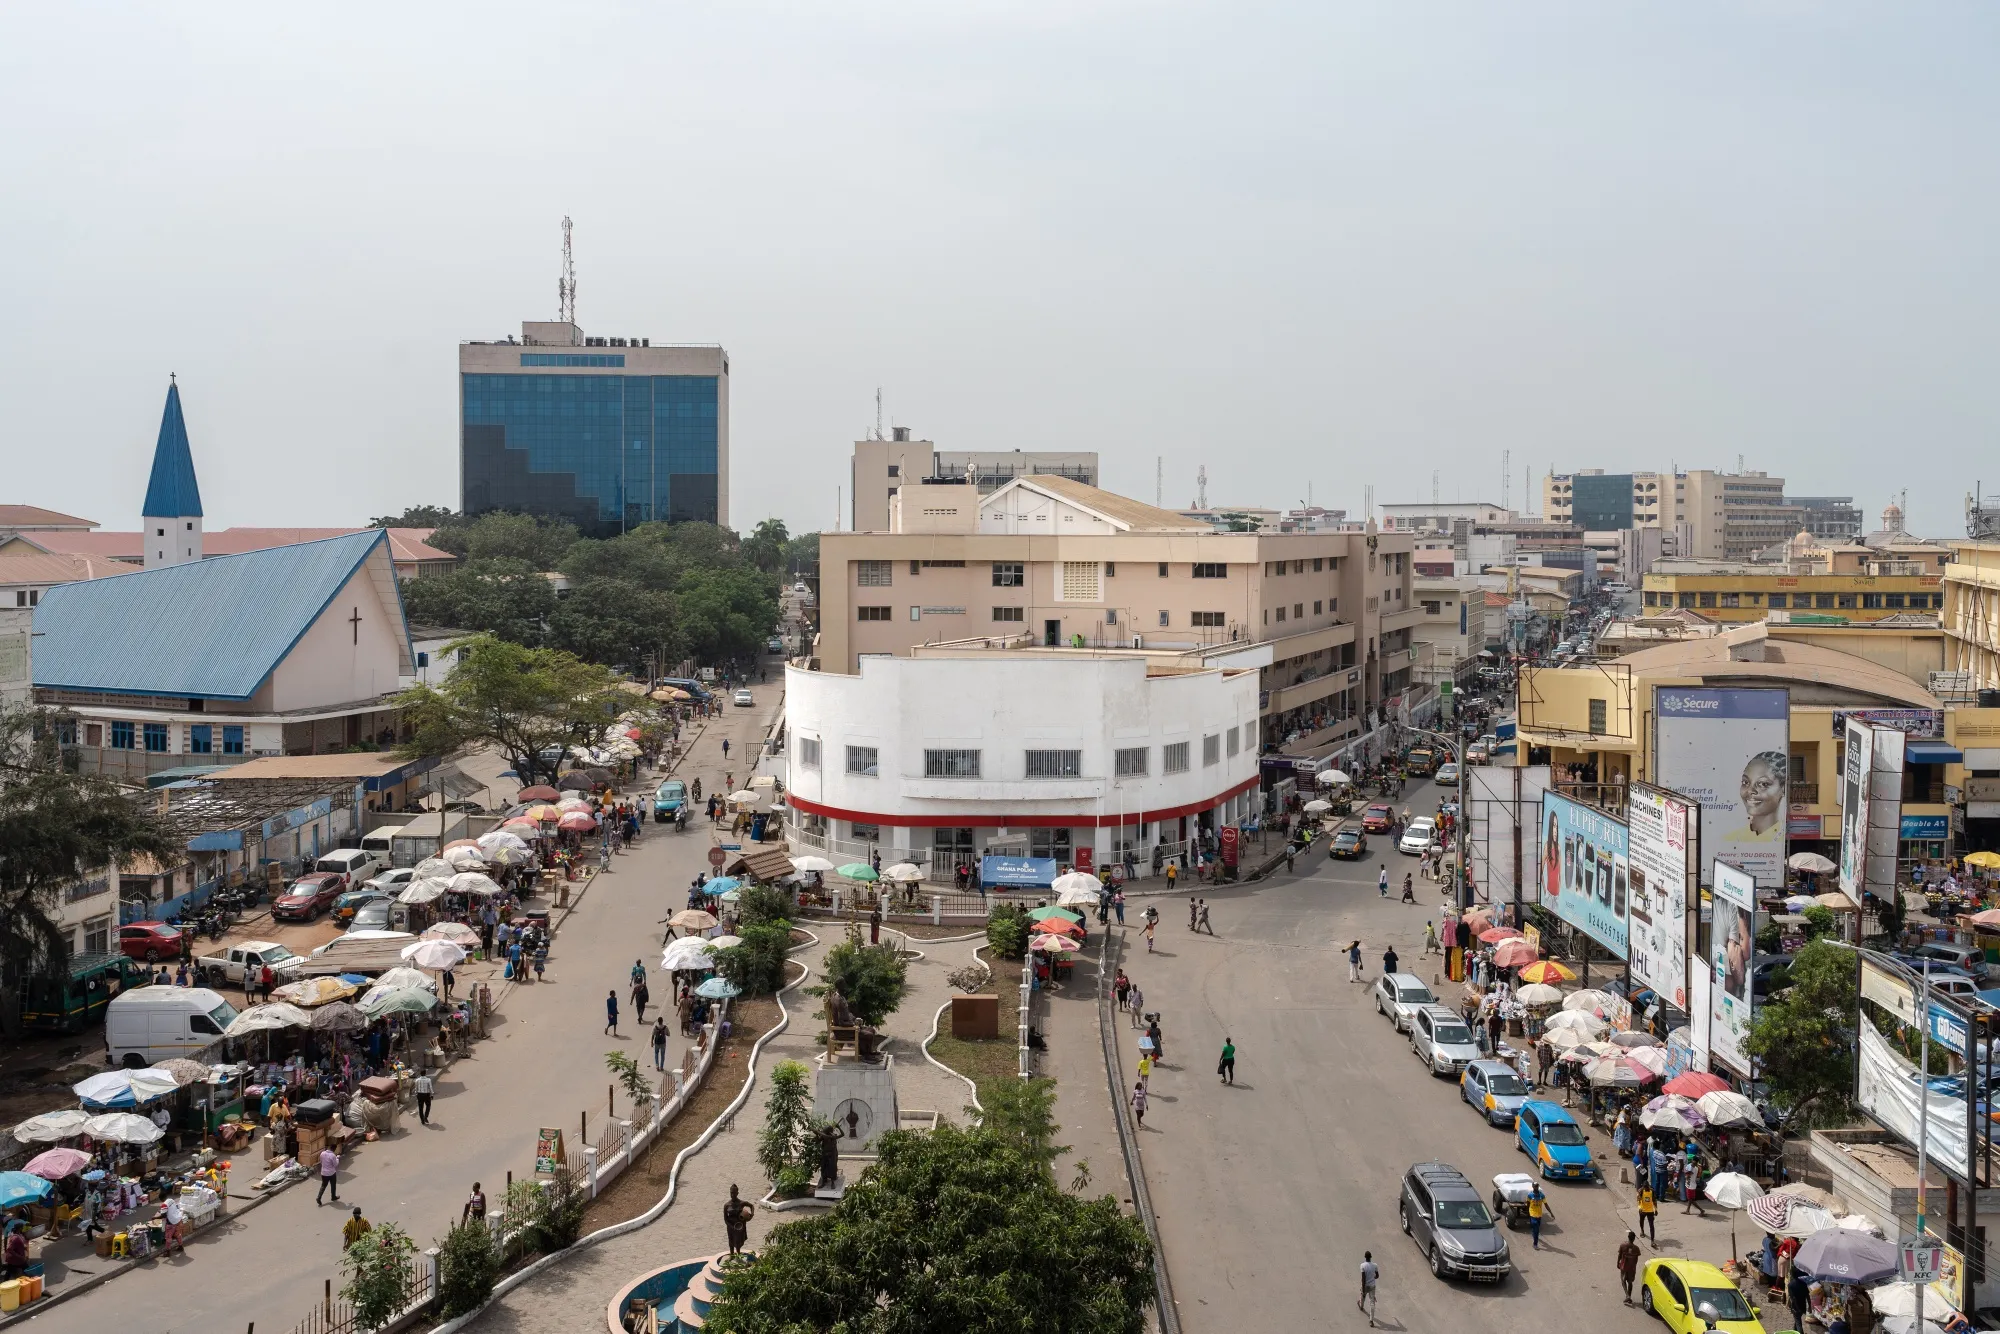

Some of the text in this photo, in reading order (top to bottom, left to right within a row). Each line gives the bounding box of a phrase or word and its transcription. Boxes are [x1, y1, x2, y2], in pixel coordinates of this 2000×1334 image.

[1853, 576, 1876, 586] Savana
[1683, 697, 1719, 709] Secure
[1848, 748, 1860, 764] GOOD
[1847, 769, 1859, 785] GOOD
[1630, 783, 1654, 800] SEWING
[1688, 787, 1706, 795] start
[1630, 797, 1663, 820] MACHINES!
[1723, 878, 1744, 896] Babymed
[1630, 943, 1651, 979] NHL
[1913, 1271, 1932, 1279] KFC
